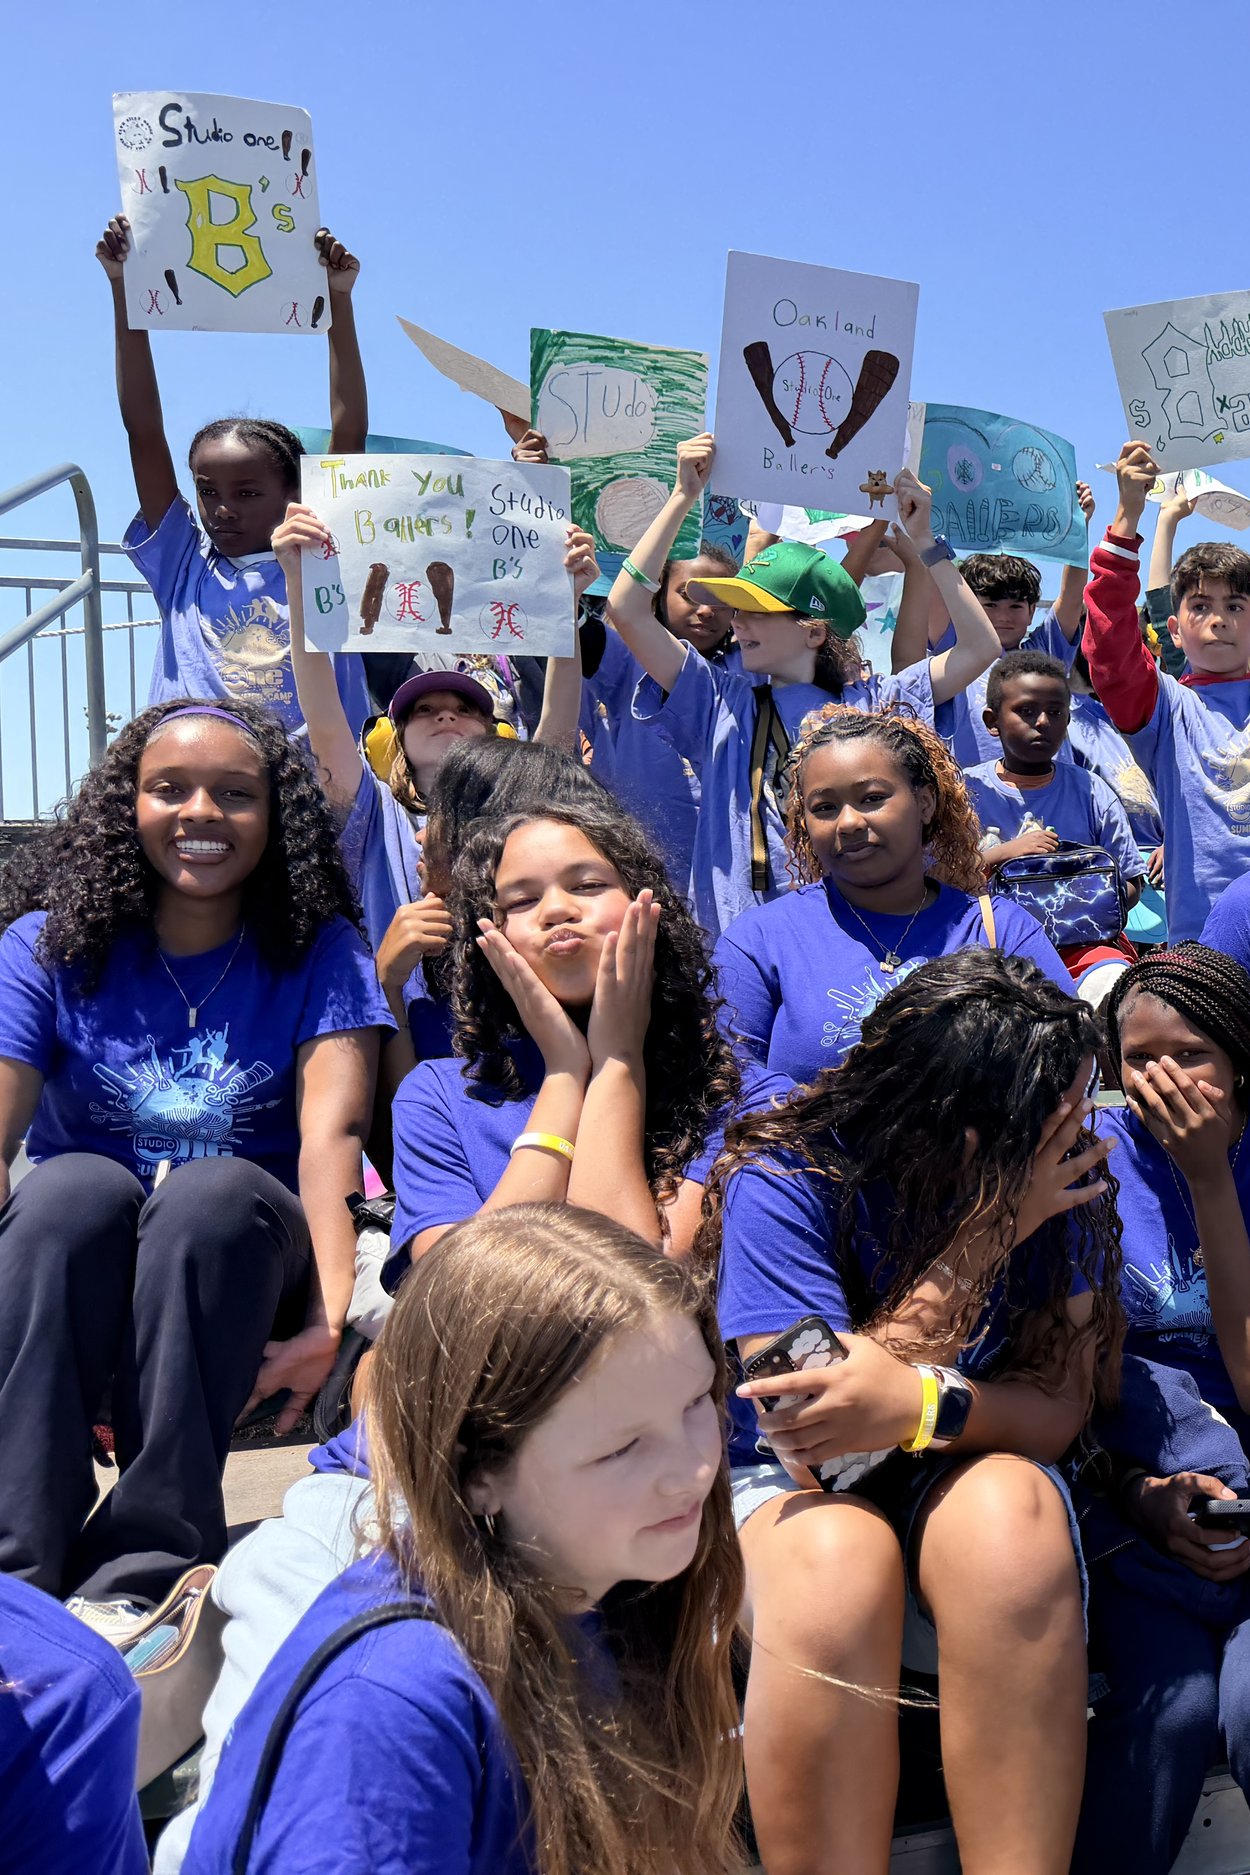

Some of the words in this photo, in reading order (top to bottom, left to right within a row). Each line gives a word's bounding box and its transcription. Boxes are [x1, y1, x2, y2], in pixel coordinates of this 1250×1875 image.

[158, 103, 233, 148] Studio
[174, 173, 296, 298] B's
[773, 298, 876, 340] Oakland
[763, 448, 834, 480] Baller's
[489, 484, 564, 521] Studio
[492, 556, 523, 580] B's
[314, 584, 346, 614] B's
[137, 1138, 176, 1149] STUDIO
